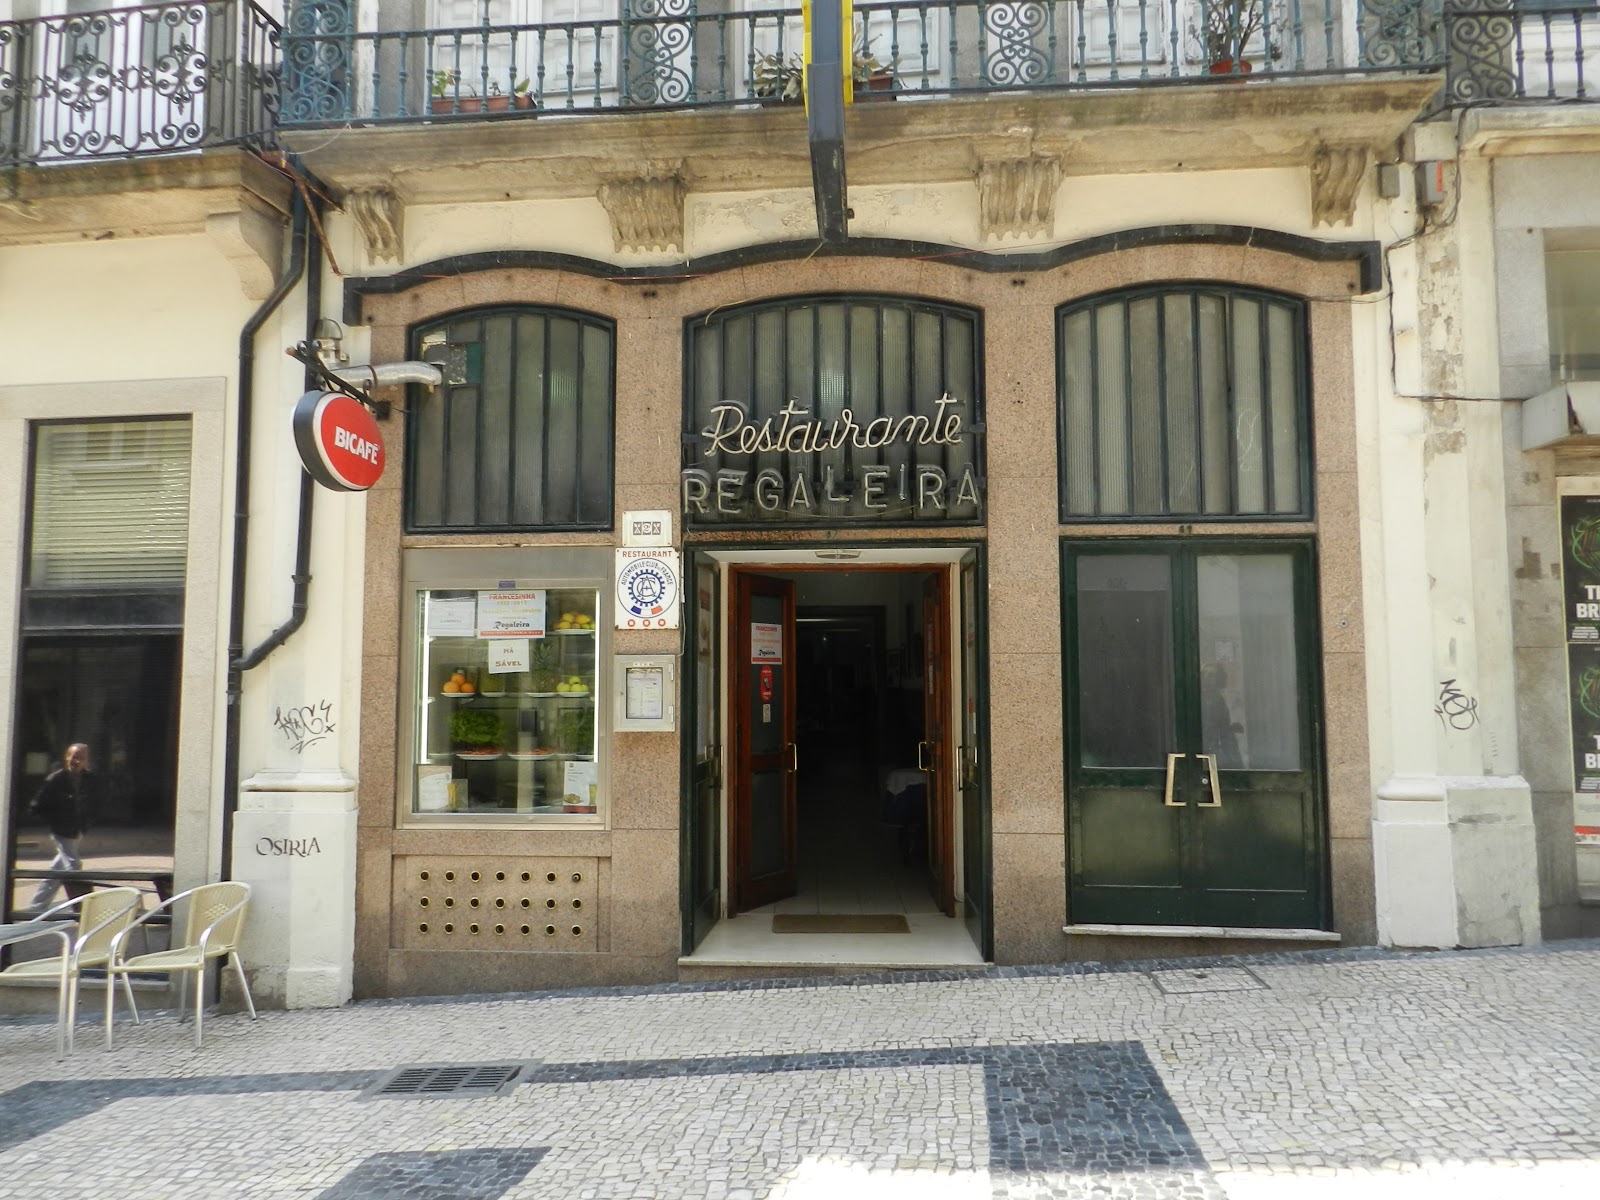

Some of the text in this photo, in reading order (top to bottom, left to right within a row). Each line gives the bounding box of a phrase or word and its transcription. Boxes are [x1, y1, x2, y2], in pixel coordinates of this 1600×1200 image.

[702, 393, 964, 457] Restaurante
[334, 425, 380, 465] BICAFÉ
[681, 463, 983, 514] REGALEIRA
[621, 561, 674, 585] AUTOMOBILE CLUB FRANCE
[495, 659, 522, 667] SÁVEL
[256, 837, 321, 857] OSIRIA
